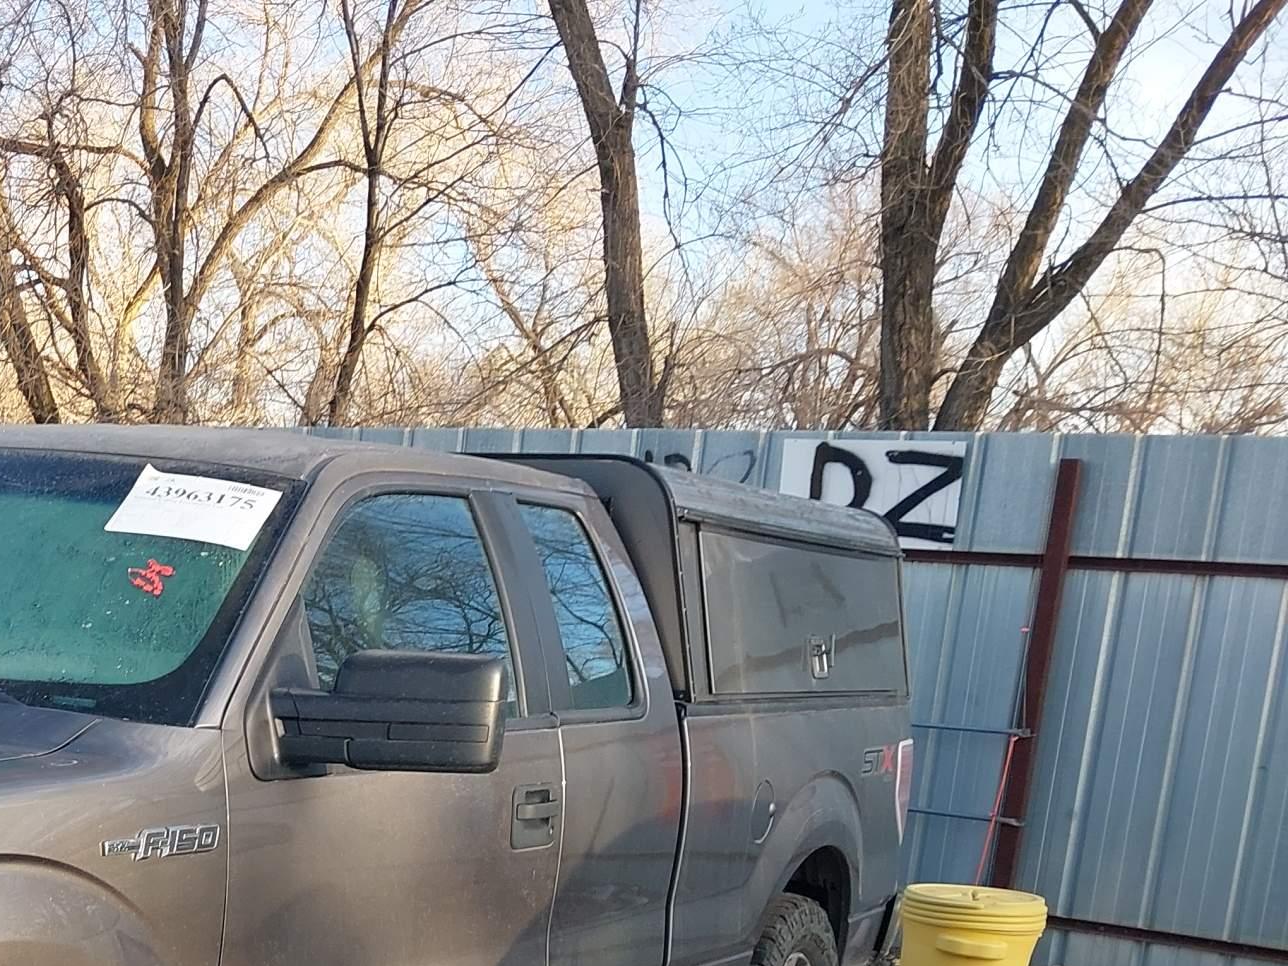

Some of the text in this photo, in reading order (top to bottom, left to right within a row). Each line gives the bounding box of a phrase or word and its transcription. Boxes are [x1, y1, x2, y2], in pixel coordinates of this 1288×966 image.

[145, 484, 257, 510] 43963175
[810, 441, 963, 543] DZ
[861, 745, 896, 776] STX
